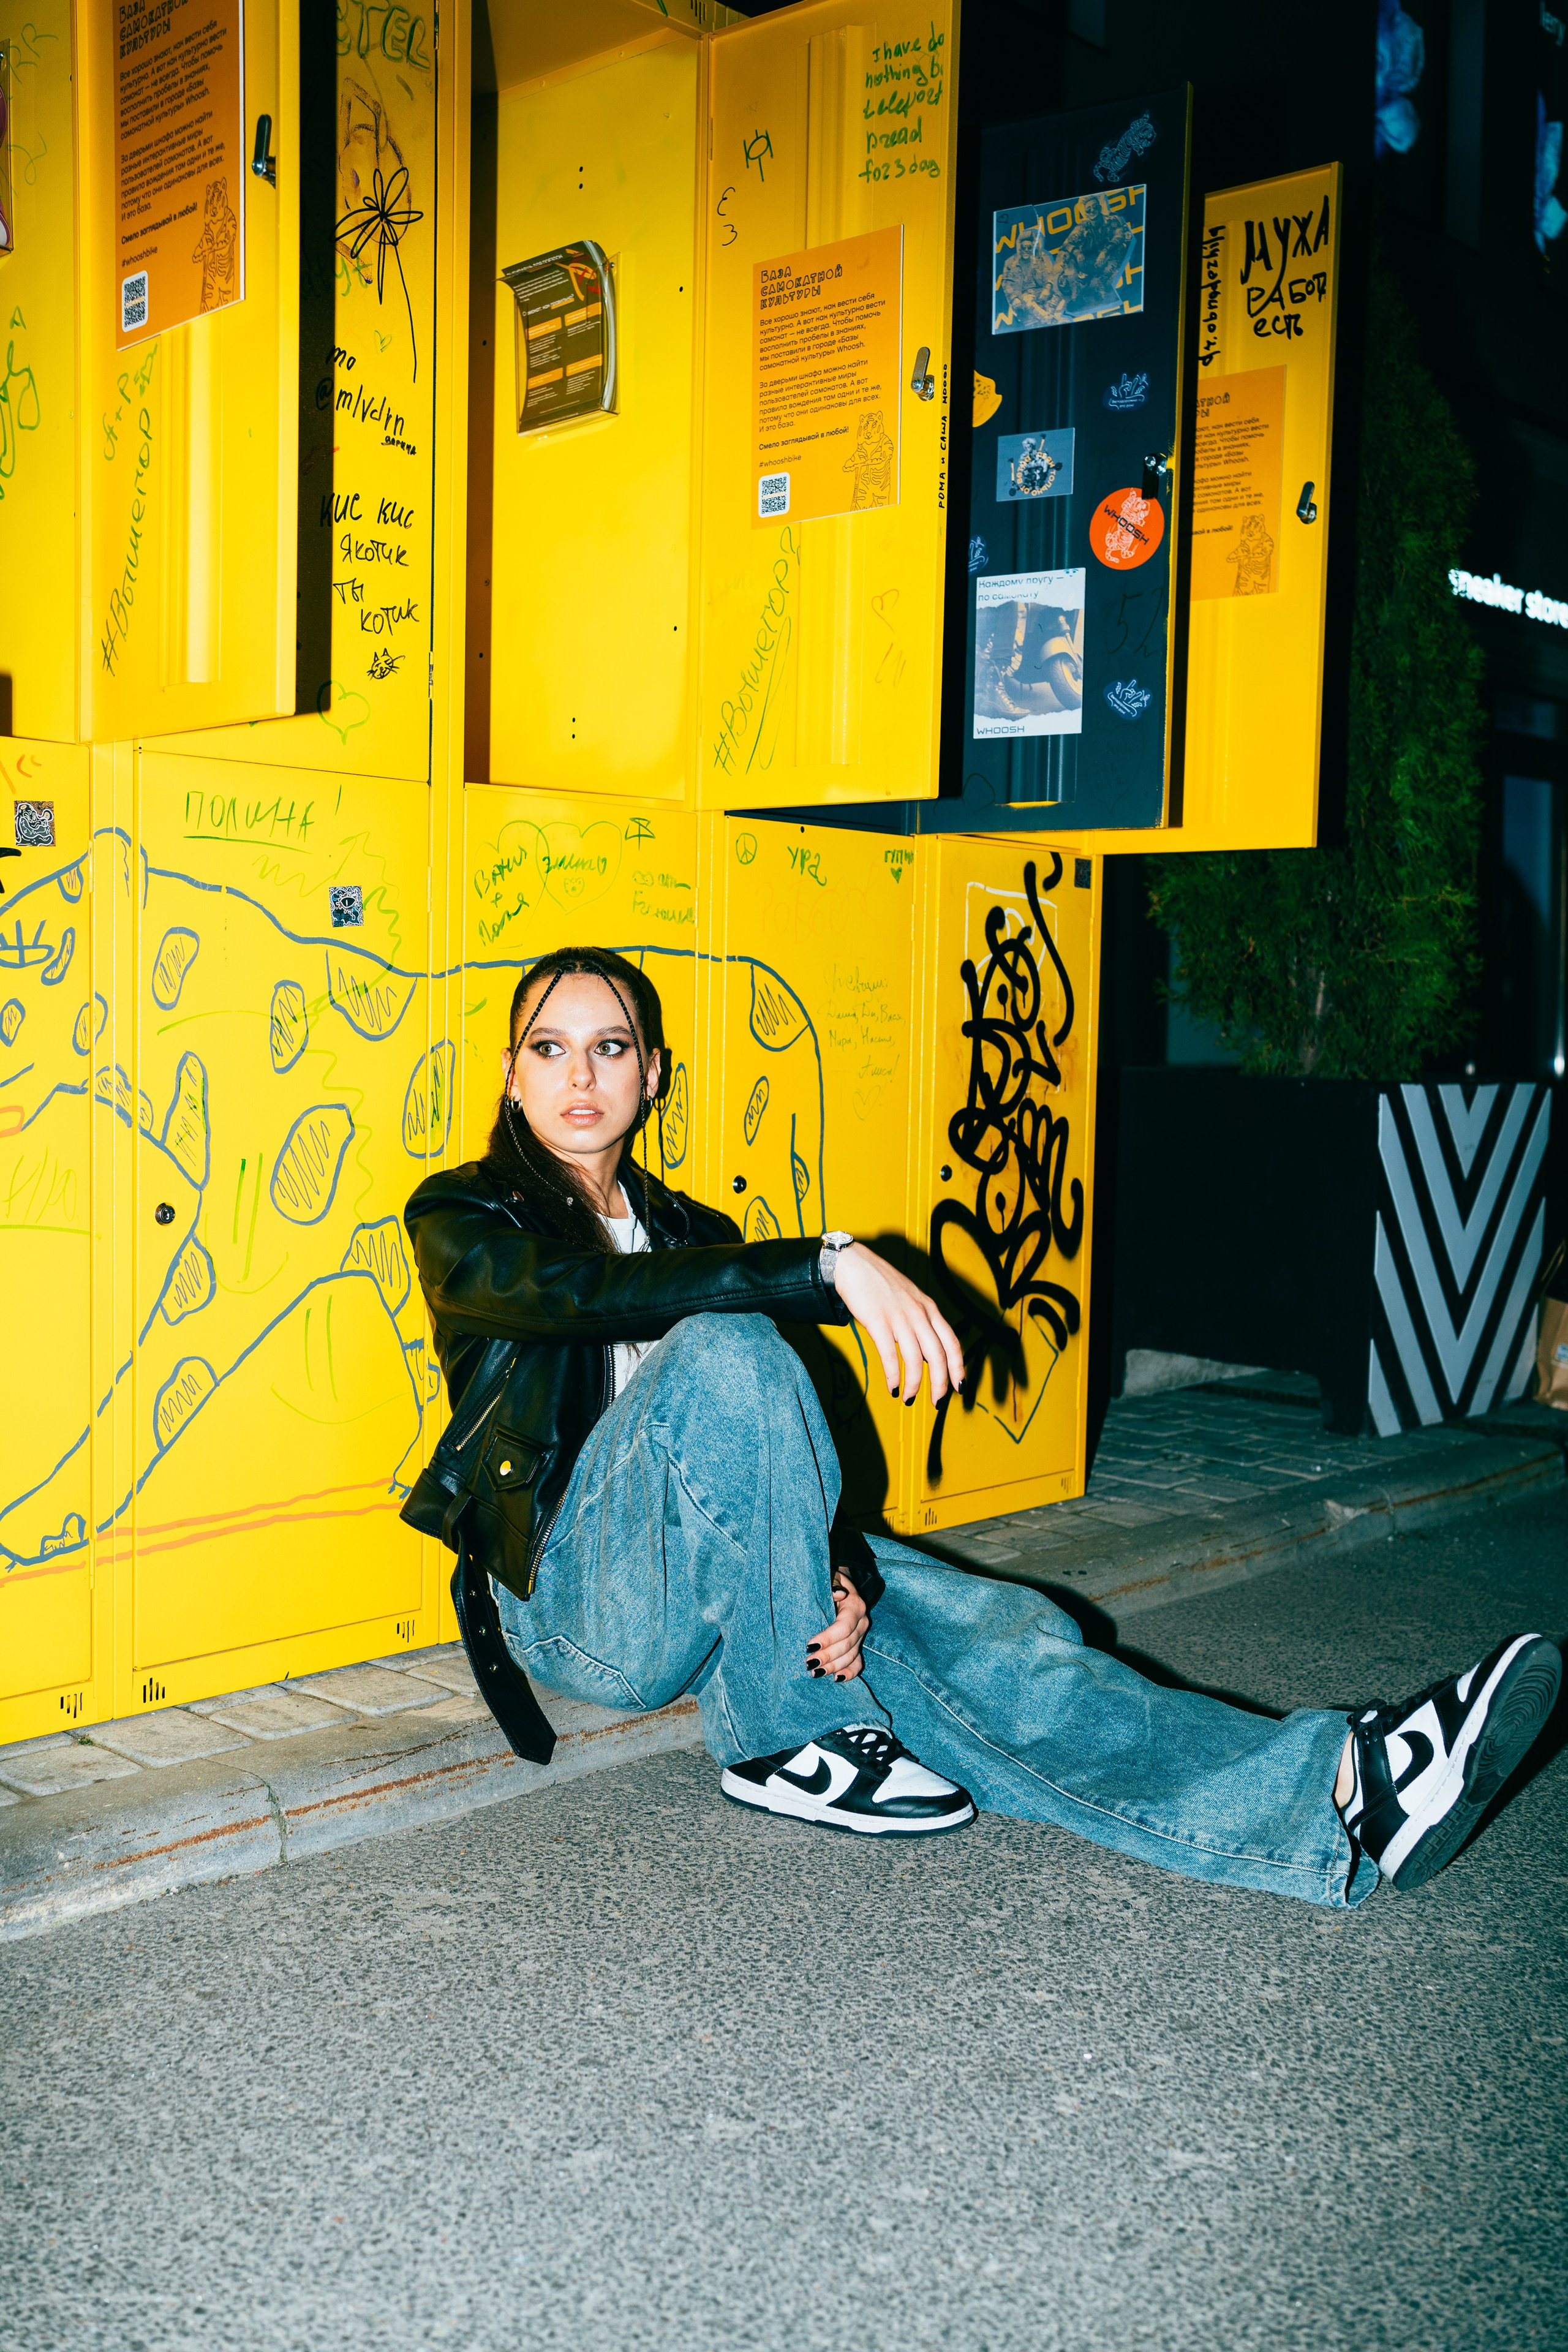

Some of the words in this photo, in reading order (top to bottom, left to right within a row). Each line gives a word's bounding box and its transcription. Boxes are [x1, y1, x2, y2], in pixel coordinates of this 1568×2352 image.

[119, 0, 145, 23] БАЗА
[119, 17, 170, 59] КУЛЬТУРЫ
[119, 70, 130, 81] Все
[131, 58, 153, 74] хорошо
[153, 47, 172, 62] знают,
[173, 40, 184, 51] как
[184, 29, 202, 45] вести
[202, 20, 217, 34] себя
[884, 37, 921, 60] have
[865, 63, 929, 88] nothing
[120, 116, 154, 140] самокатной
[155, 102, 184, 123] культуры»
[185, 86, 210, 105] Whoosh.
[121, 154, 128, 164] За
[129, 141, 153, 160] дверьми
[154, 130, 173, 147] шкафа
[174, 120, 194, 136] можно
[195, 110, 213, 125] найти
[121, 231, 139, 244] Смело
[140, 213, 172, 236] заглядывай
[178, 202, 197, 219] любой!
[1240, 194, 1330, 285] МУХА
[121, 246, 157, 267] #whooshbike
[760, 263, 842, 296] САМОКАТНОЙ
[761, 266, 791, 283] БАЗА
[760, 284, 821, 310] КУЛЬТУРЫ
[773, 312, 799, 323] хорошо
[800, 306, 822, 317] знают,
[837, 298, 856, 307] вести
[858, 292, 875, 302] себя
[760, 322, 794, 336] культурно.
[829, 305, 864, 319] культурно
[865, 300, 886, 309] вести
[760, 333, 788, 344] самокат
[805, 323, 831, 333] всегда.
[832, 316, 853, 326] Чтобы
[855, 311, 881, 321] помочь
[760, 340, 797, 353] восполнить
[799, 332, 829, 344] пробелы
[835, 323, 866, 335] знаниях,
[771, 347, 805, 359] поставили
[812, 339, 836, 349] городе
[837, 334, 858, 343] «Базы
[760, 355, 799, 371] самокатной
[801, 349, 835, 362] культуры»
[837, 341, 865, 353] Whoosh.
[759, 387, 783, 399] разные
[785, 375, 836, 391] интерактивные
[838, 371, 856, 380] миры
[769, 375, 797, 387] дверьми
[799, 370, 821, 380] шкафа
[823, 364, 846, 374] можно
[847, 360, 867, 368] найти
[759, 390, 809, 405] пользователей
[810, 382, 848, 395] самокатов.
[759, 404, 787, 415] правила
[788, 397, 821, 409] вождения
[837, 390, 854, 398] одни
[759, 415, 782, 423] потому
[809, 401, 847, 413] одинаковы
[758, 442, 779, 450] Смело
[780, 432, 819, 446] заглядывай
[826, 426, 848, 437] любой!
[759, 454, 801, 467] #whooshbike
[1104, 504, 1150, 546] WHOOSH
[979, 579, 1024, 589] Каждому
[976, 725, 1025, 735] WHOOSH
